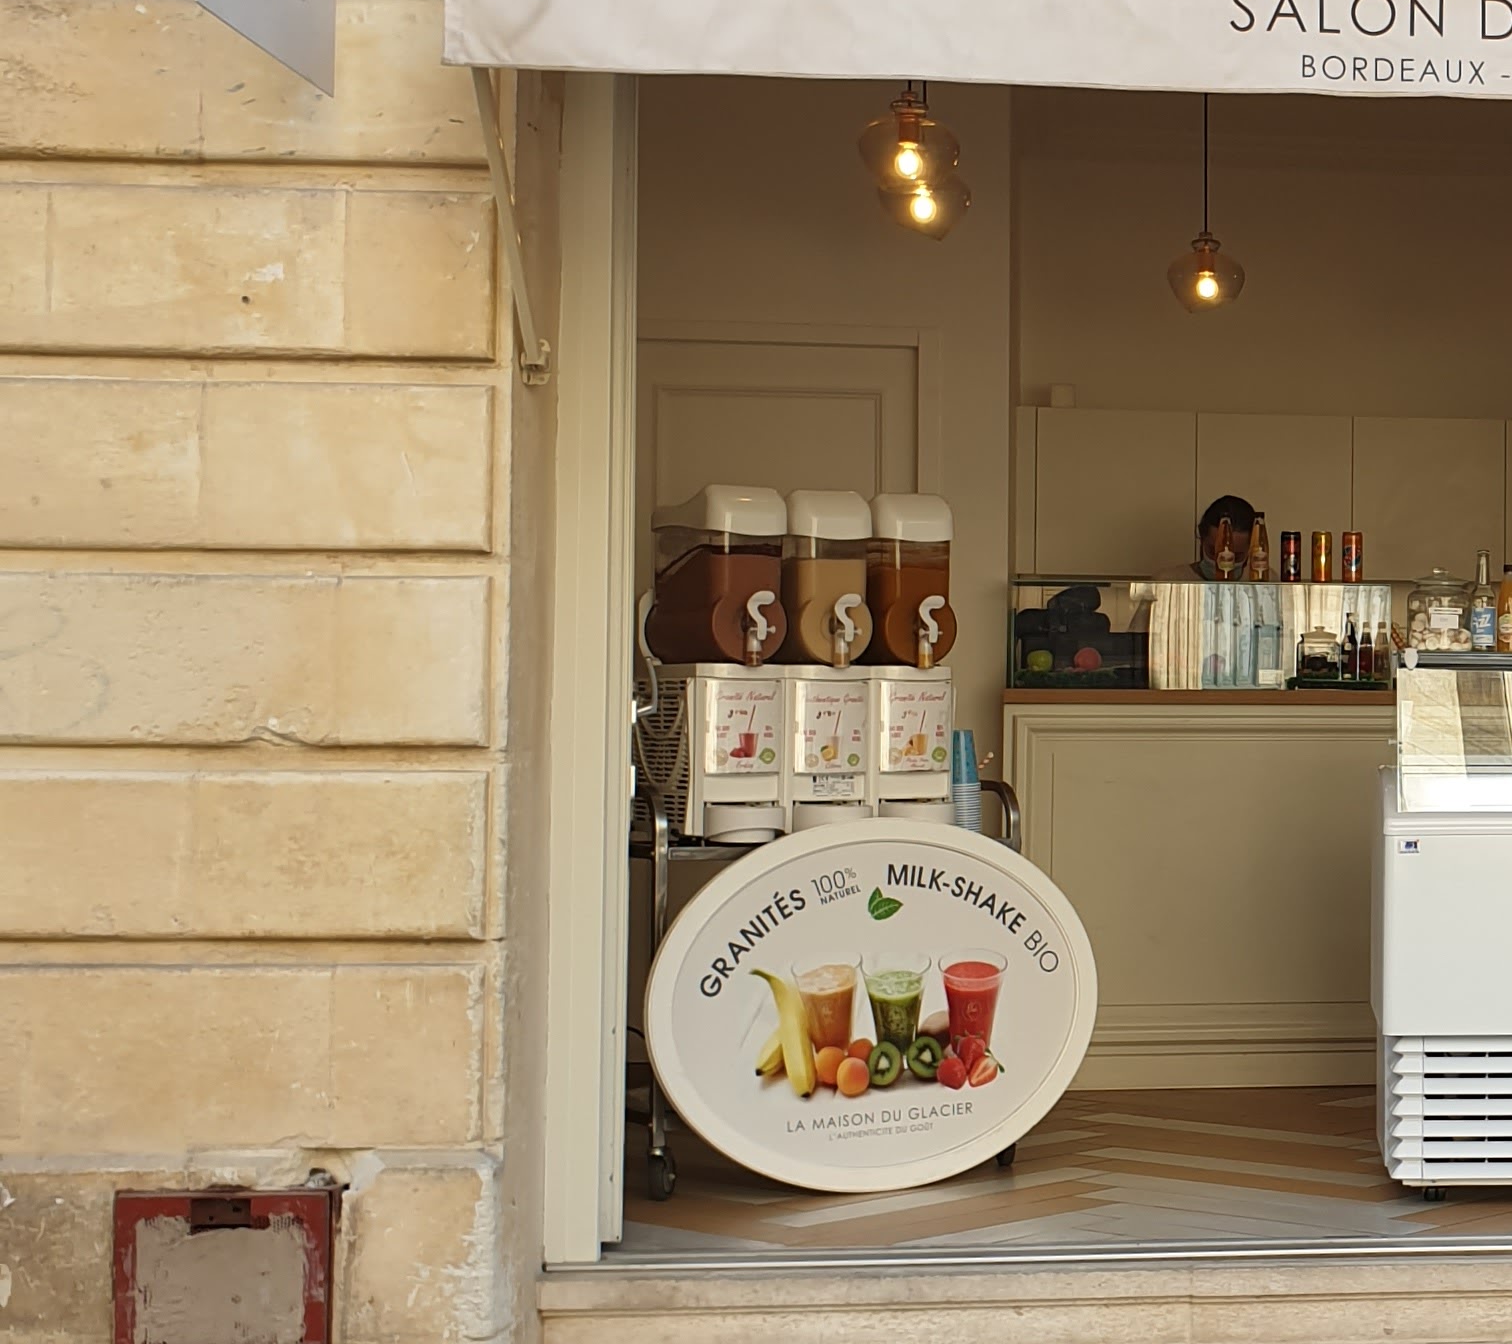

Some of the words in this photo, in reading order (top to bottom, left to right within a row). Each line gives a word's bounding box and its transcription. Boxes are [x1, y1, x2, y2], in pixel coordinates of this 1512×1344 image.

[1301, 54, 1486, 86] BORDEAUX
[810, 867, 857, 897] 100%
[819, 884, 862, 906] NATUREL
[886, 863, 1028, 935] MILK-SHAKE
[1022, 929, 1060, 973] BIO
[699, 889, 807, 998] GRANITÉS
[785, 1119, 806, 1134] LA
[811, 1111, 876, 1132] MAISON
[880, 1109, 902, 1124] DU
[907, 1101, 975, 1122] GLACIER
